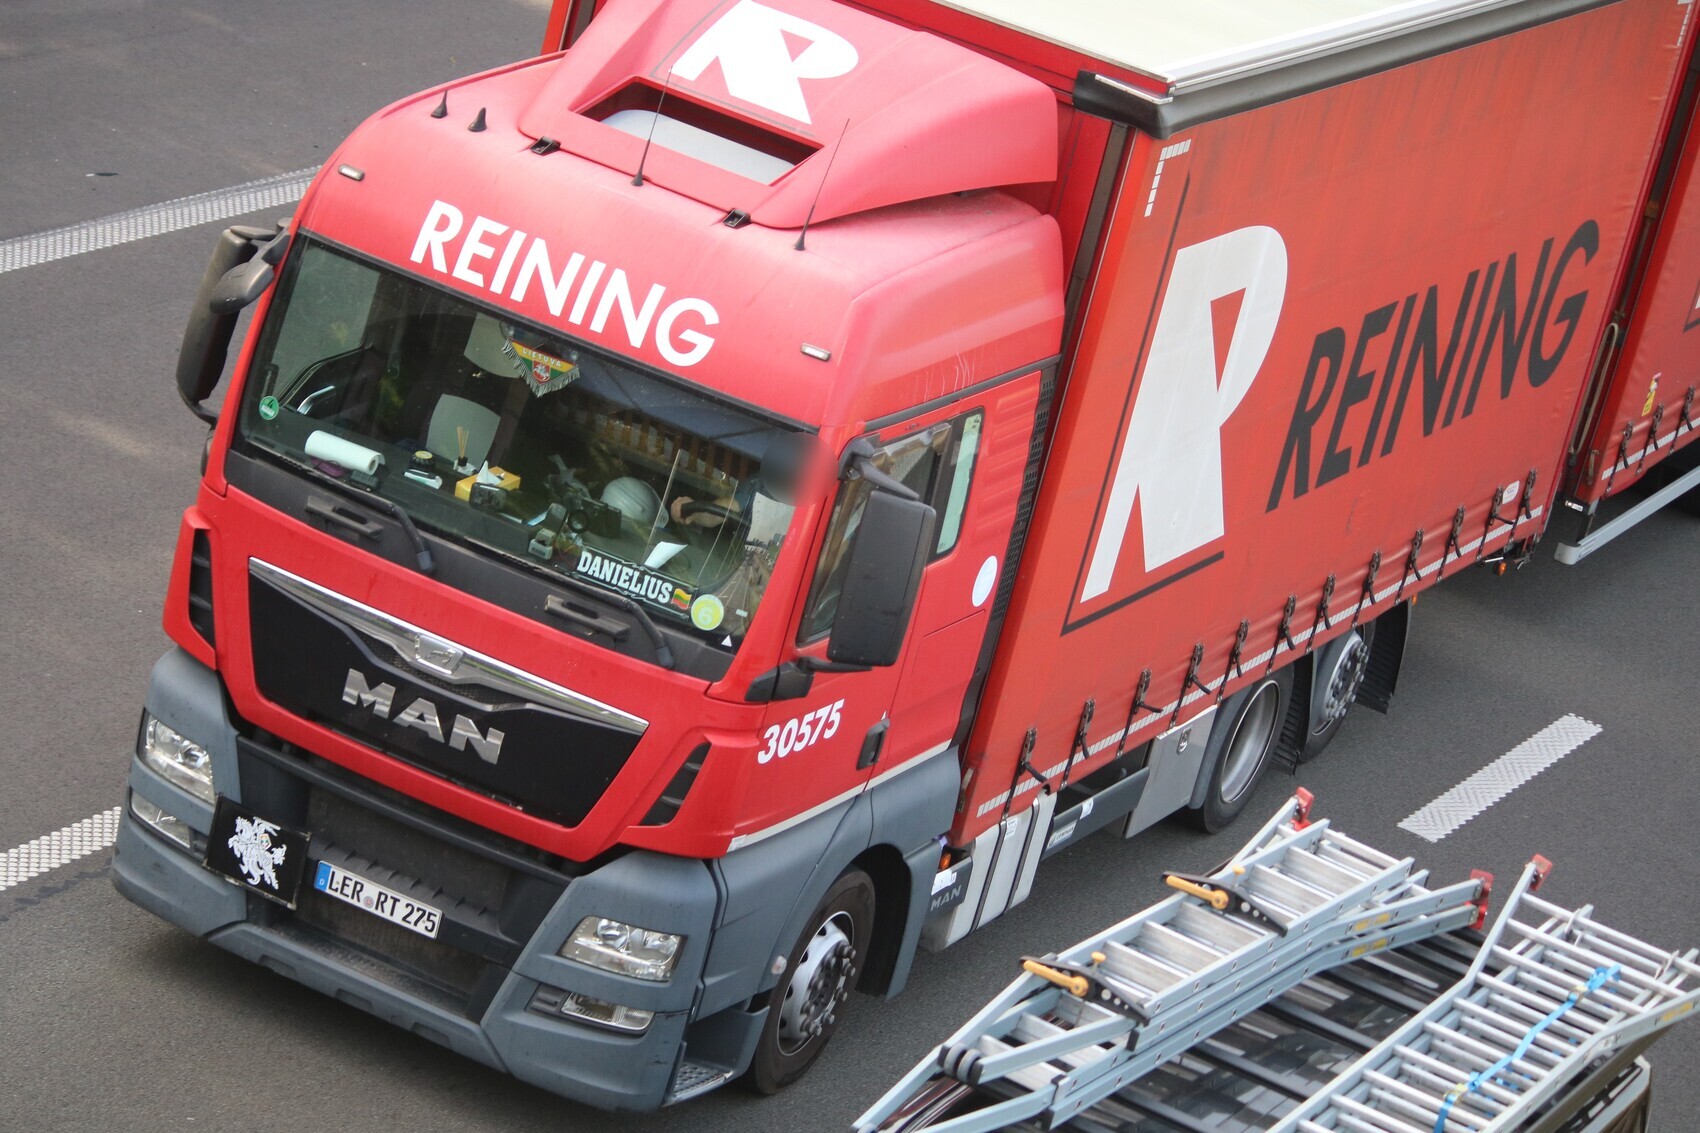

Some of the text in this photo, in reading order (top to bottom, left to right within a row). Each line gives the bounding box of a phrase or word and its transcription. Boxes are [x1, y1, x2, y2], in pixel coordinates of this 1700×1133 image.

[409, 199, 720, 367] REINING
[522, 346, 562, 368] LIETUVA
[1265, 219, 1600, 513] REINING
[1080, 225, 1288, 603] R
[576, 550, 674, 604] DANIELIUS
[697, 607, 713, 626] 6
[342, 668, 505, 765] MAN
[757, 698, 845, 765] 30575
[328, 870, 364, 903] LER
[374, 890, 401, 917] RT
[401, 902, 438, 933] 275
[930, 884, 962, 911] MAN
